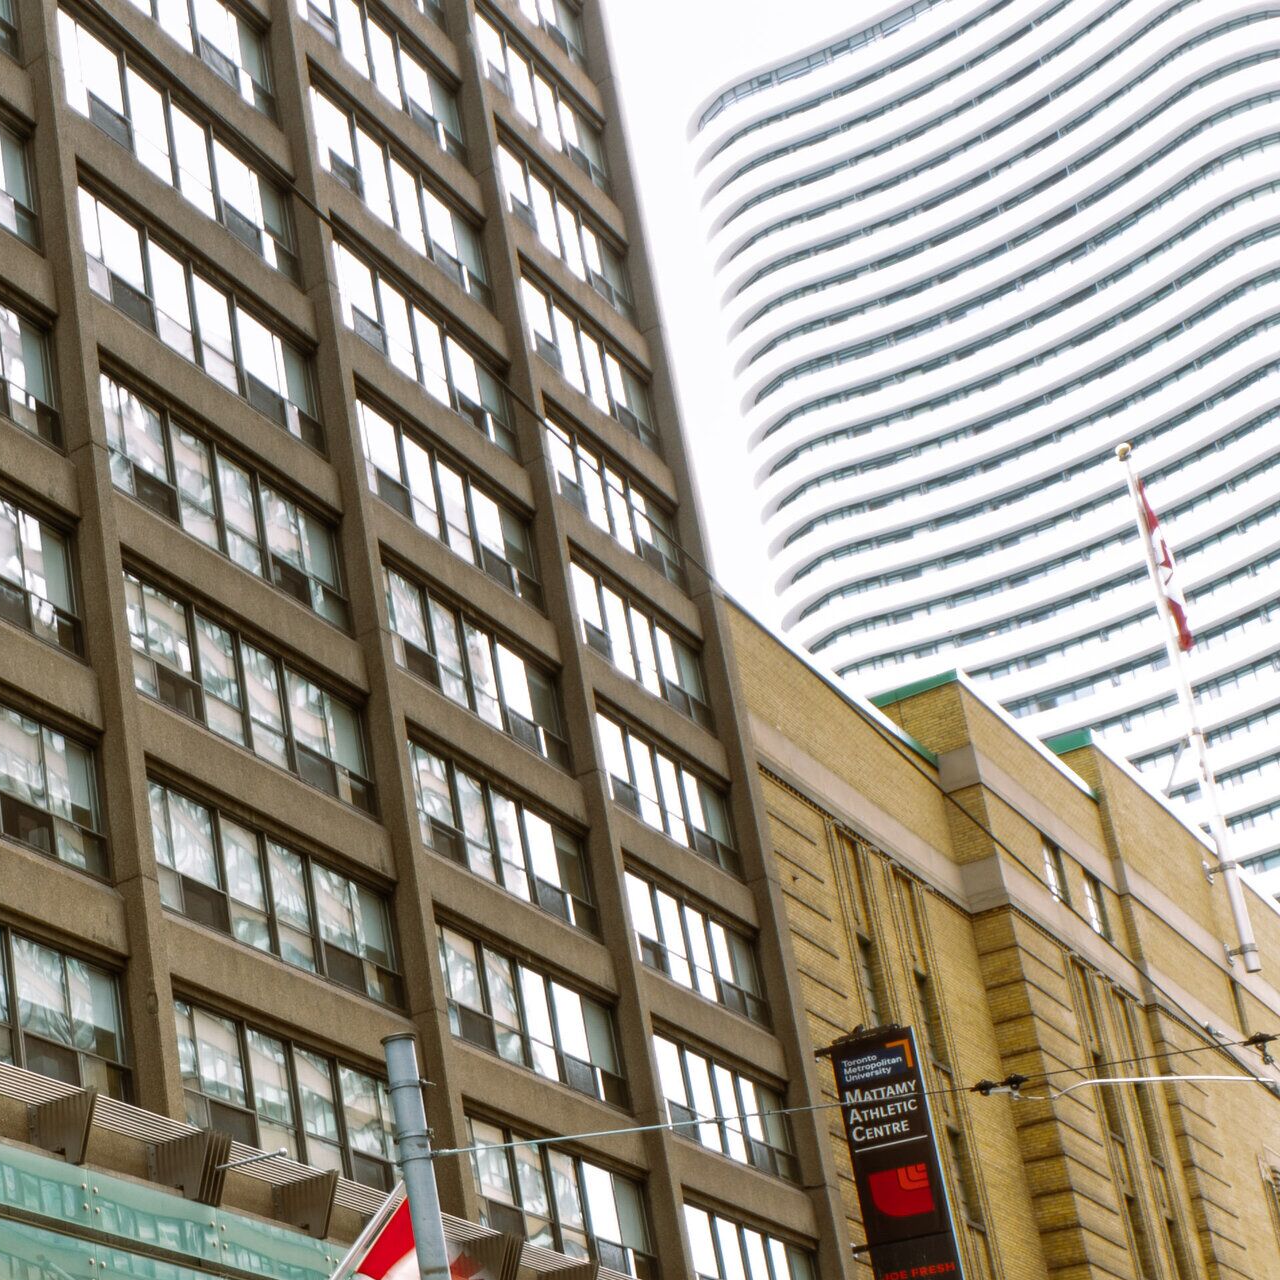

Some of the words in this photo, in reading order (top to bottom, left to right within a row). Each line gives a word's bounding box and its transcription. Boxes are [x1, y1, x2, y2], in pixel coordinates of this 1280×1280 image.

[842, 1055, 877, 1068] Toronto
[843, 1056, 902, 1075] Metropolitan
[845, 1067, 891, 1082] University
[849, 1099, 918, 1125] ATHLETIC
[852, 1120, 910, 1142] CENTRE
[912, 1262, 956, 1278] FRESH
